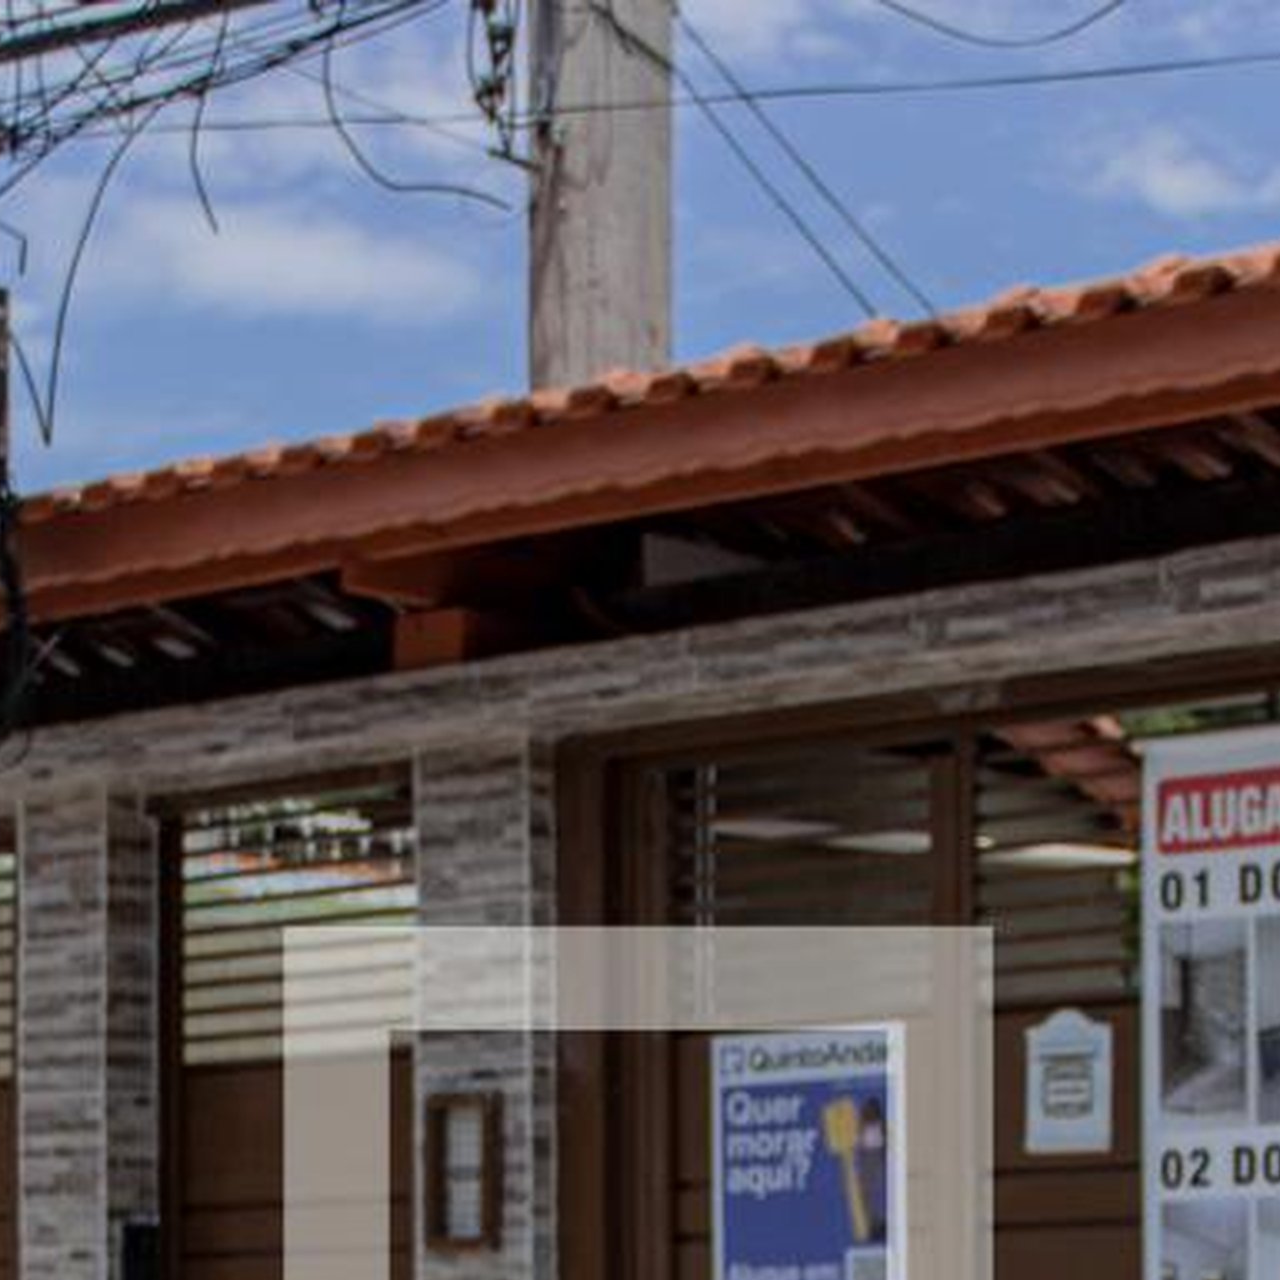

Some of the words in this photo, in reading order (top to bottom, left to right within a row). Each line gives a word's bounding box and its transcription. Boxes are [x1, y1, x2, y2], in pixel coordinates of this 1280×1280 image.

[1161, 871, 1211, 911] 01
[726, 1091, 803, 1125] Quer
[726, 1128, 818, 1158] morar
[727, 1157, 812, 1200] aqui?
[1161, 1149, 1211, 1190] 02
